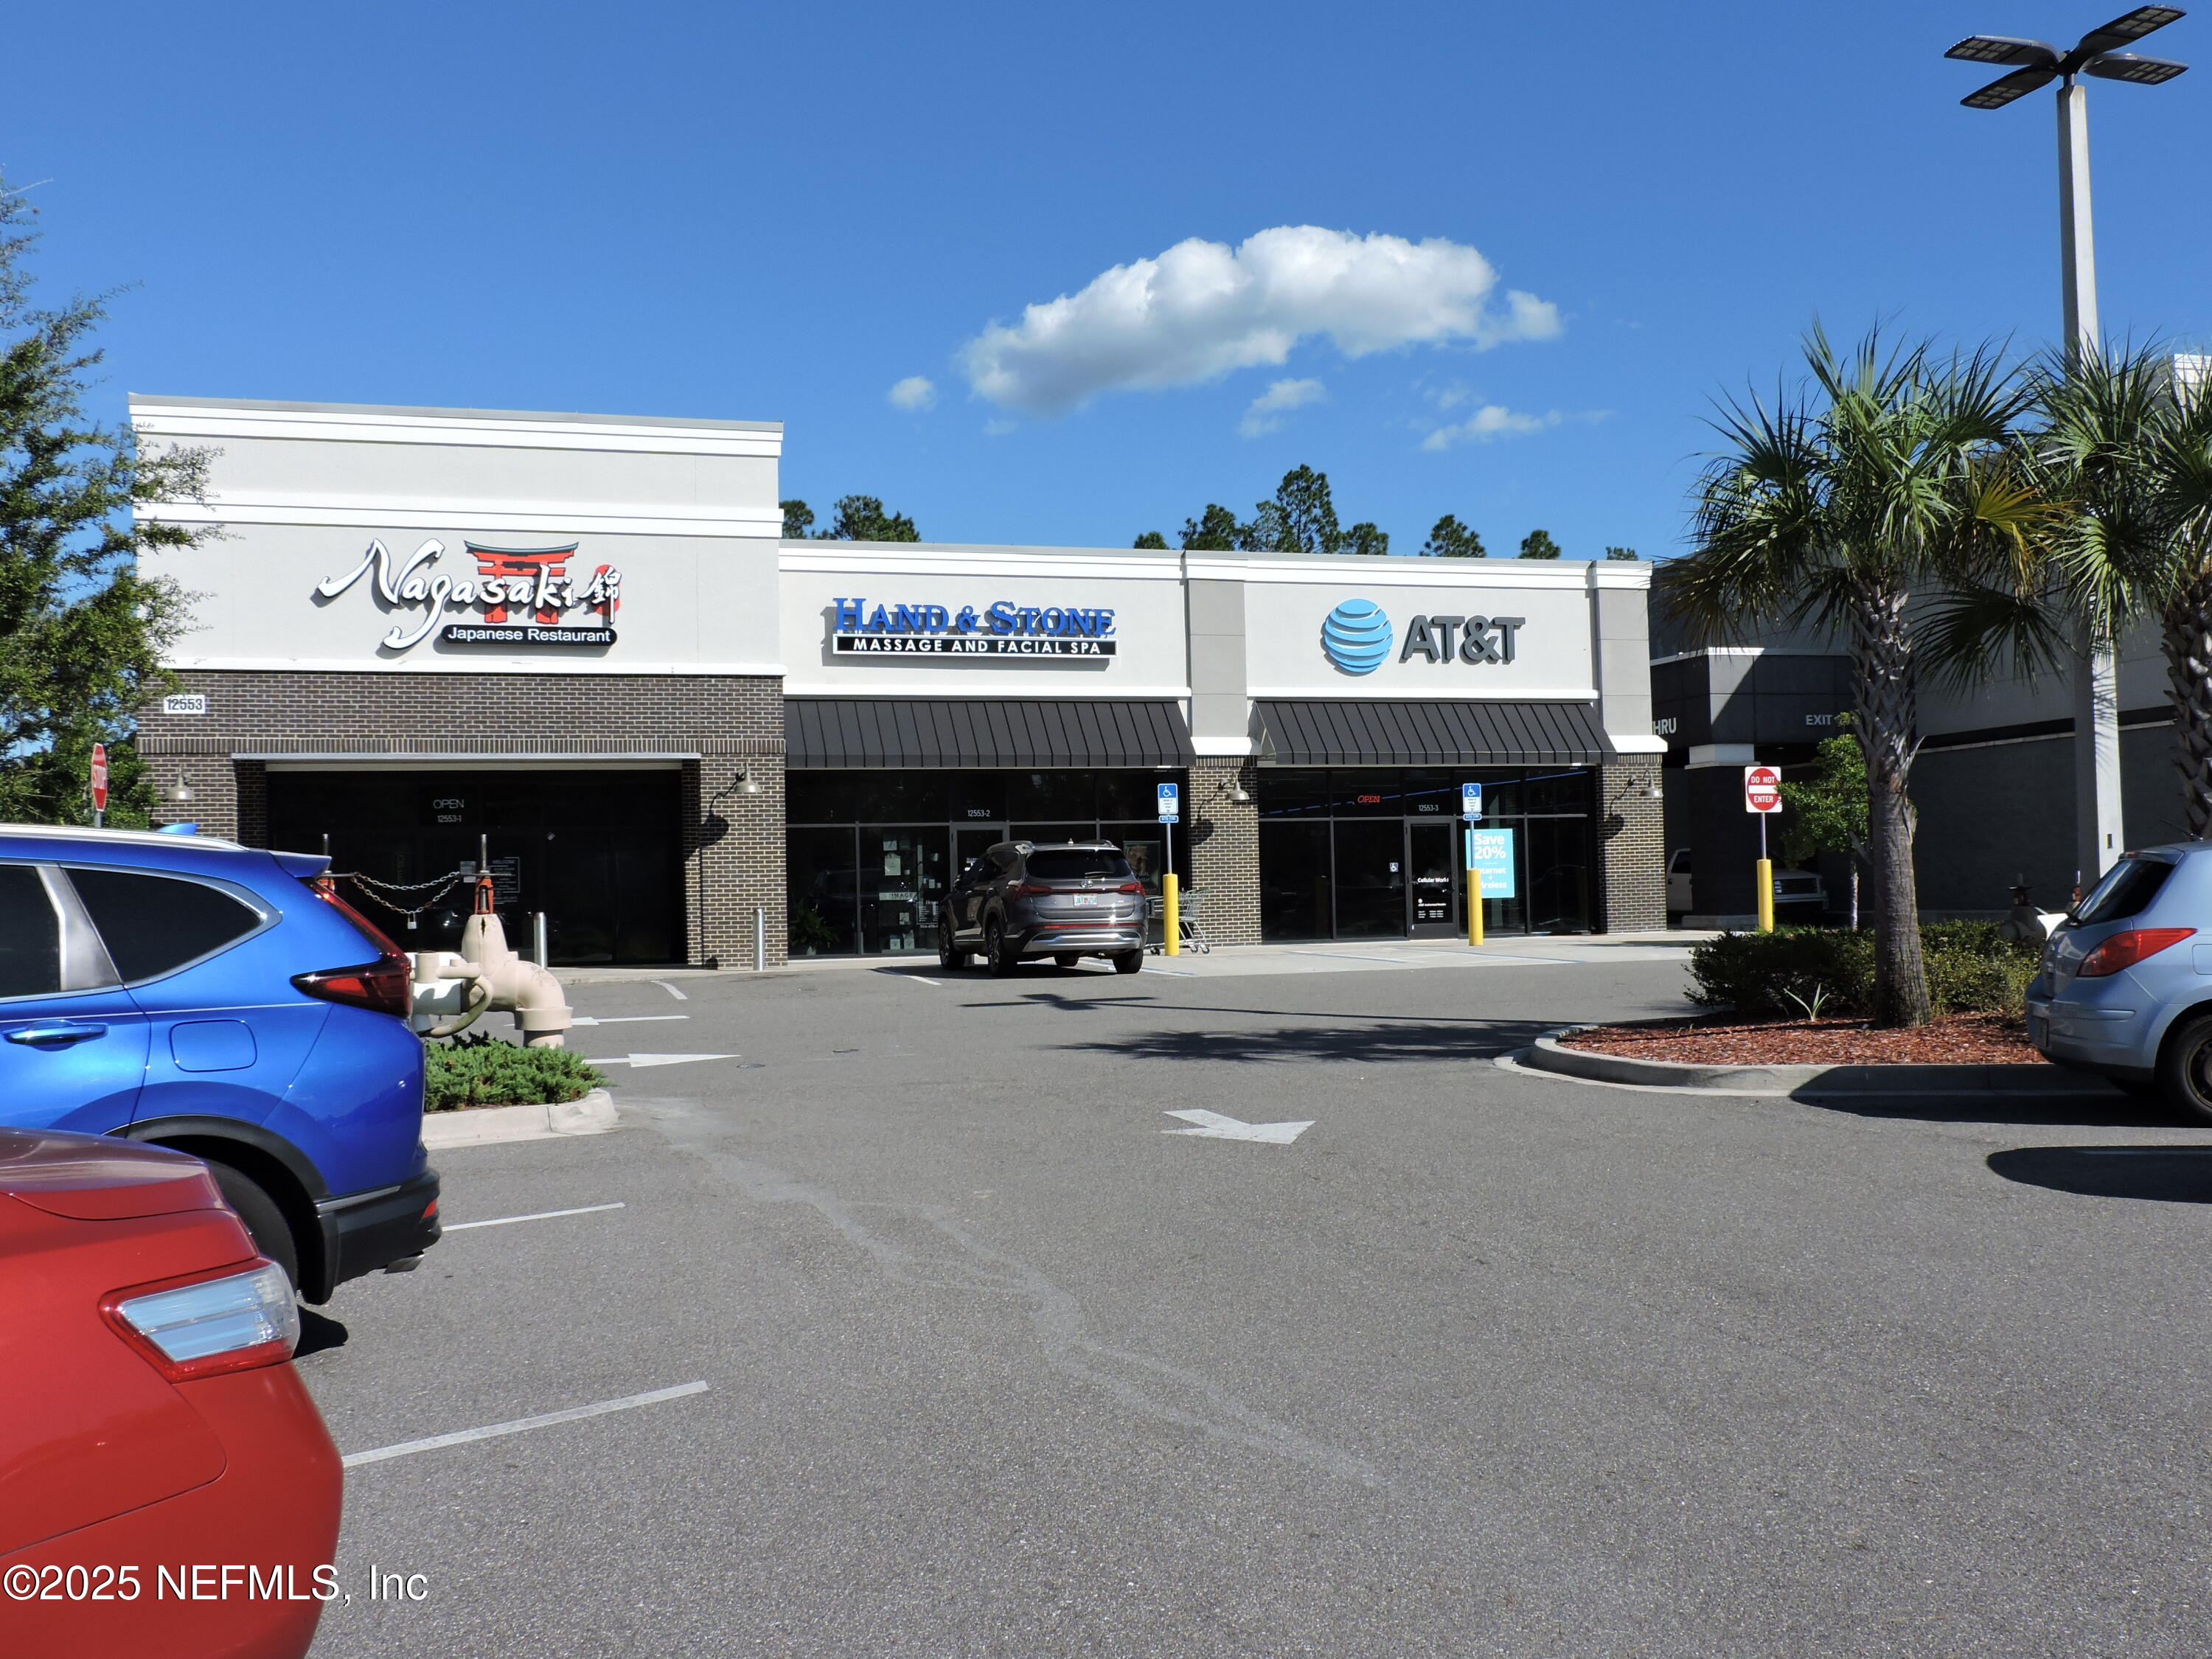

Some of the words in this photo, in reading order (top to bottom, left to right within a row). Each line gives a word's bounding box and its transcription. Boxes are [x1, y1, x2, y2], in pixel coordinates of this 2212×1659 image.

[318, 538, 574, 649] Nagasaki
[832, 597, 949, 632] HAND
[956, 605, 980, 632] &
[989, 600, 1116, 636] STONE
[448, 627, 523, 642] Japanese
[528, 627, 611, 642] Restaurant
[1402, 614, 1526, 661] AT&T
[853, 638, 942, 653] MASSAGE
[952, 641, 988, 653] AND
[998, 641, 1062, 654] FACIAL
[1071, 642, 1101, 655] SPA
[167, 698, 203, 710] 12553
[1652, 717, 1677, 735] HRU
[1805, 714, 1833, 726] EXIT
[433, 799, 465, 809] OPEN
[1753, 796, 1774, 804] ENTER
[437, 815, 462, 823] 12553-1
[1474, 832, 1505, 845] Save
[1474, 846, 1506, 860] 20%
